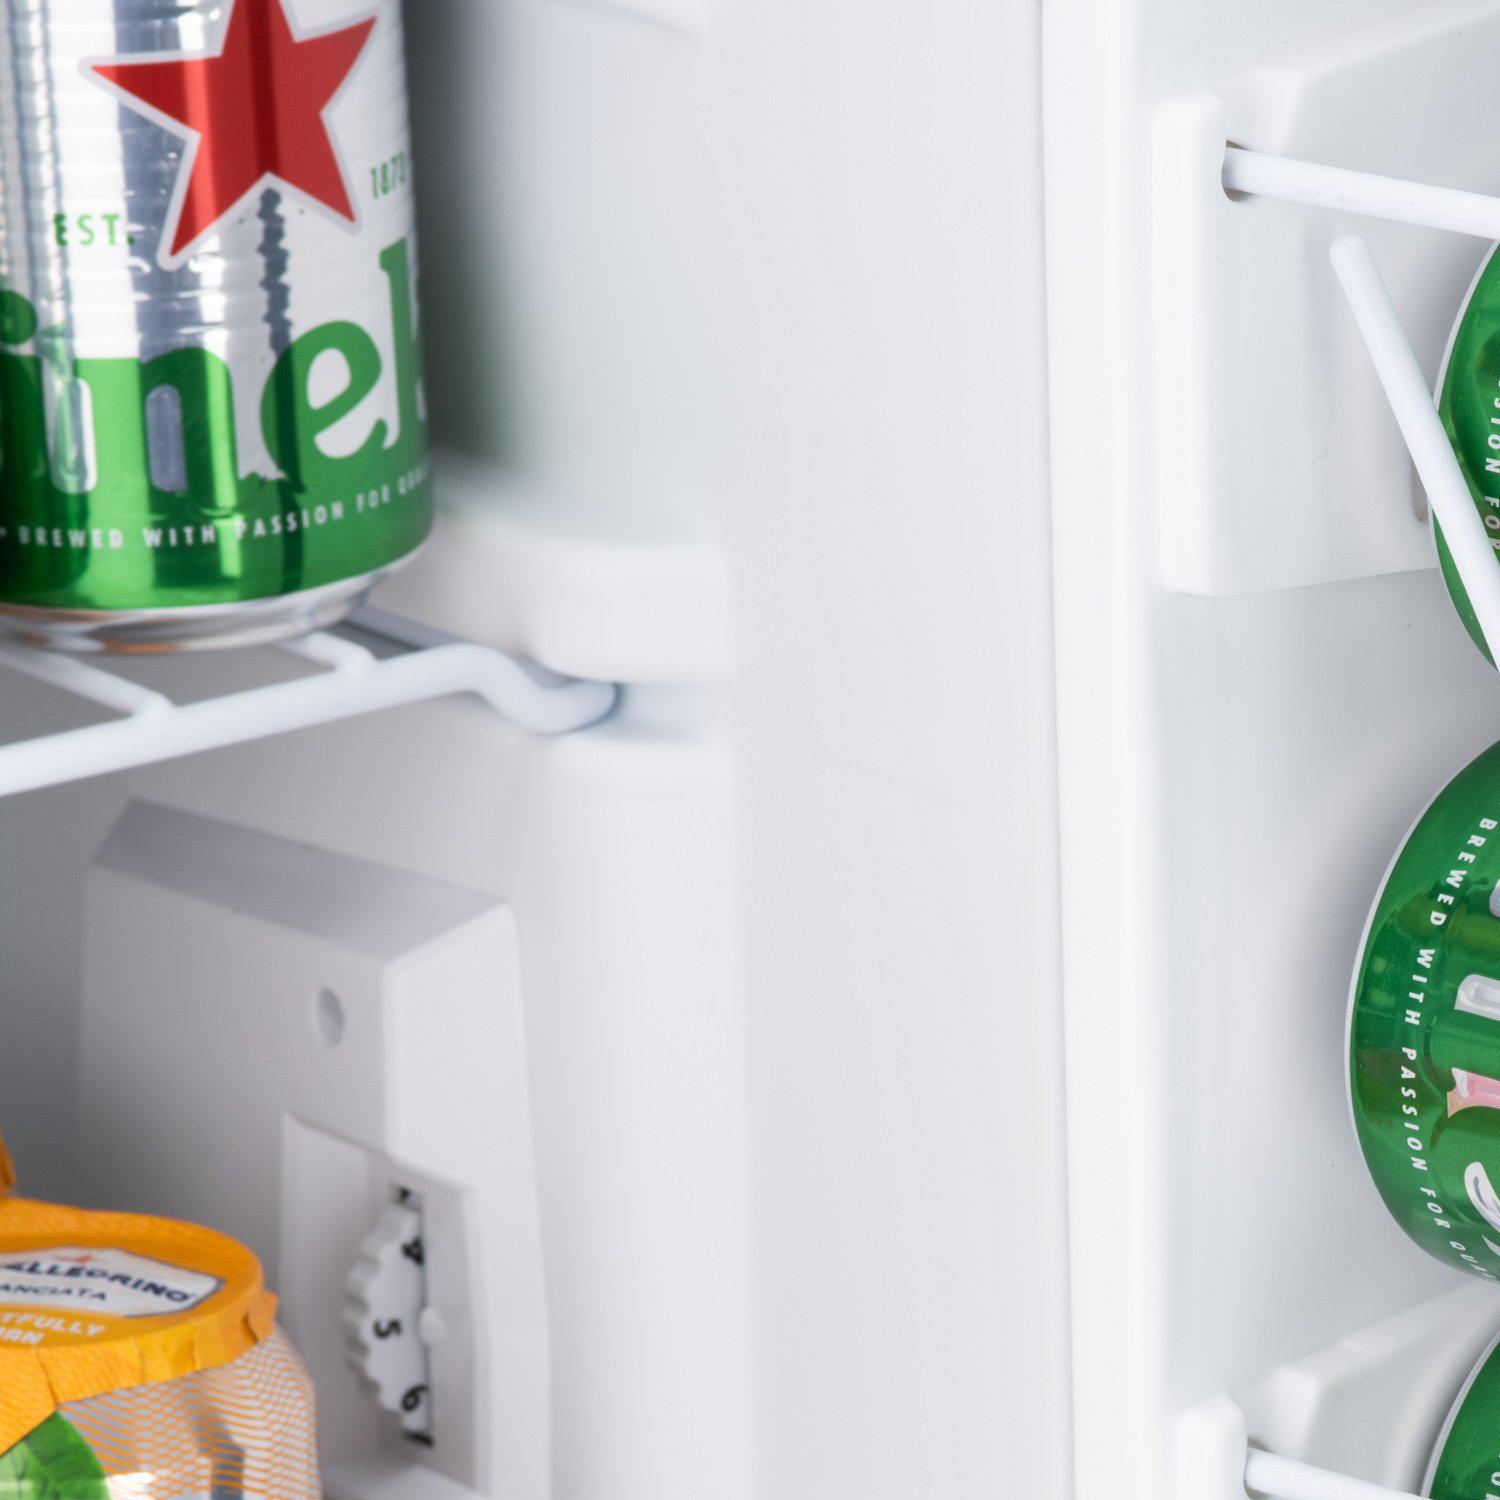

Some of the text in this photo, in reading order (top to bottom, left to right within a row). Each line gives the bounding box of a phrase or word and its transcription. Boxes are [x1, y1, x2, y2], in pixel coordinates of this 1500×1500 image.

[54, 213, 136, 247] EST.
[19, 486, 390, 549] BREWED WITH PASSION FOR
[1430, 817, 1498, 926] BREWED
[1403, 949, 1435, 1027] WITH
[1401, 1047, 1428, 1172] PASSION
[1420, 1185, 1451, 1231] FOR
[373, 1318, 402, 1339] 5
